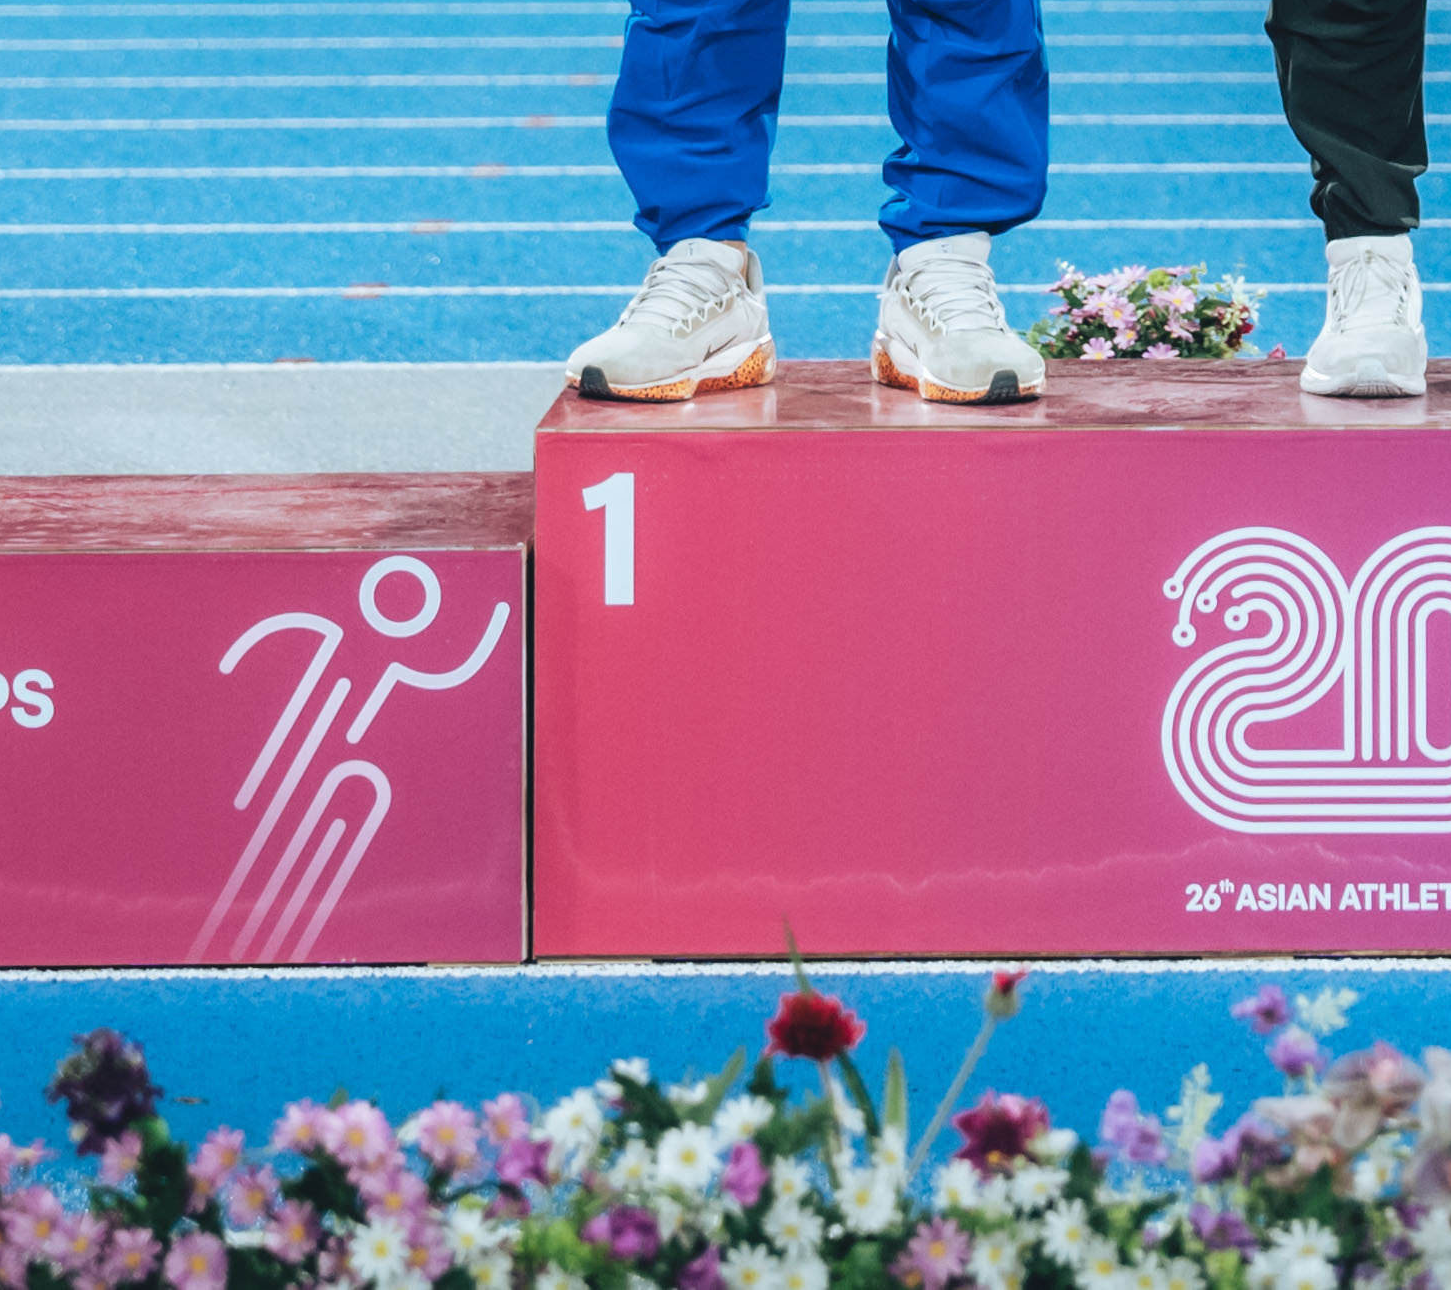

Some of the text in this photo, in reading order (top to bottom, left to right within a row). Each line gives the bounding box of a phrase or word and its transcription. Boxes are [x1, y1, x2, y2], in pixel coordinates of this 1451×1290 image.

[582, 473, 634, 605] 1
[1185, 878, 1236, 913] 26th
[1236, 882, 1332, 912] ASIAN
